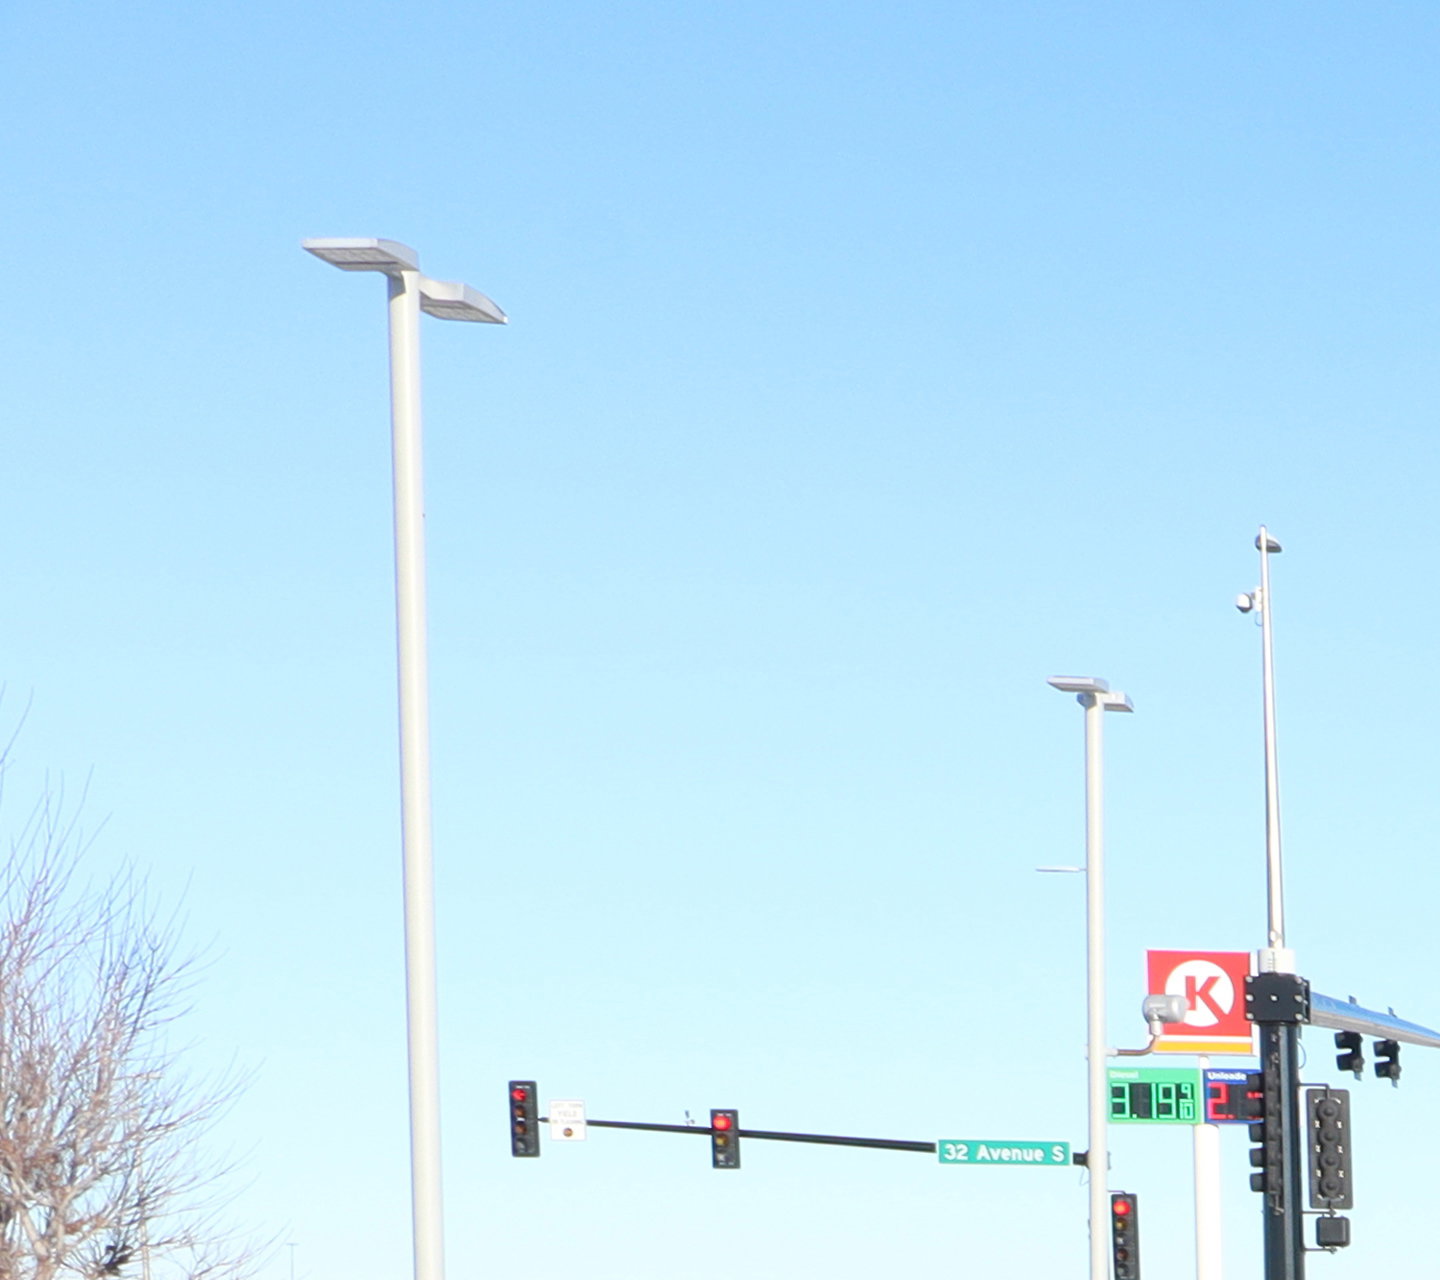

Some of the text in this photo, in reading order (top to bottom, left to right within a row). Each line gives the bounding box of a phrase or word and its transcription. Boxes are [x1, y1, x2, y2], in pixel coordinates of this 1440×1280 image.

[1185, 975, 1229, 1016] K
[944, 1143, 1065, 1162] 32 Avenue S
